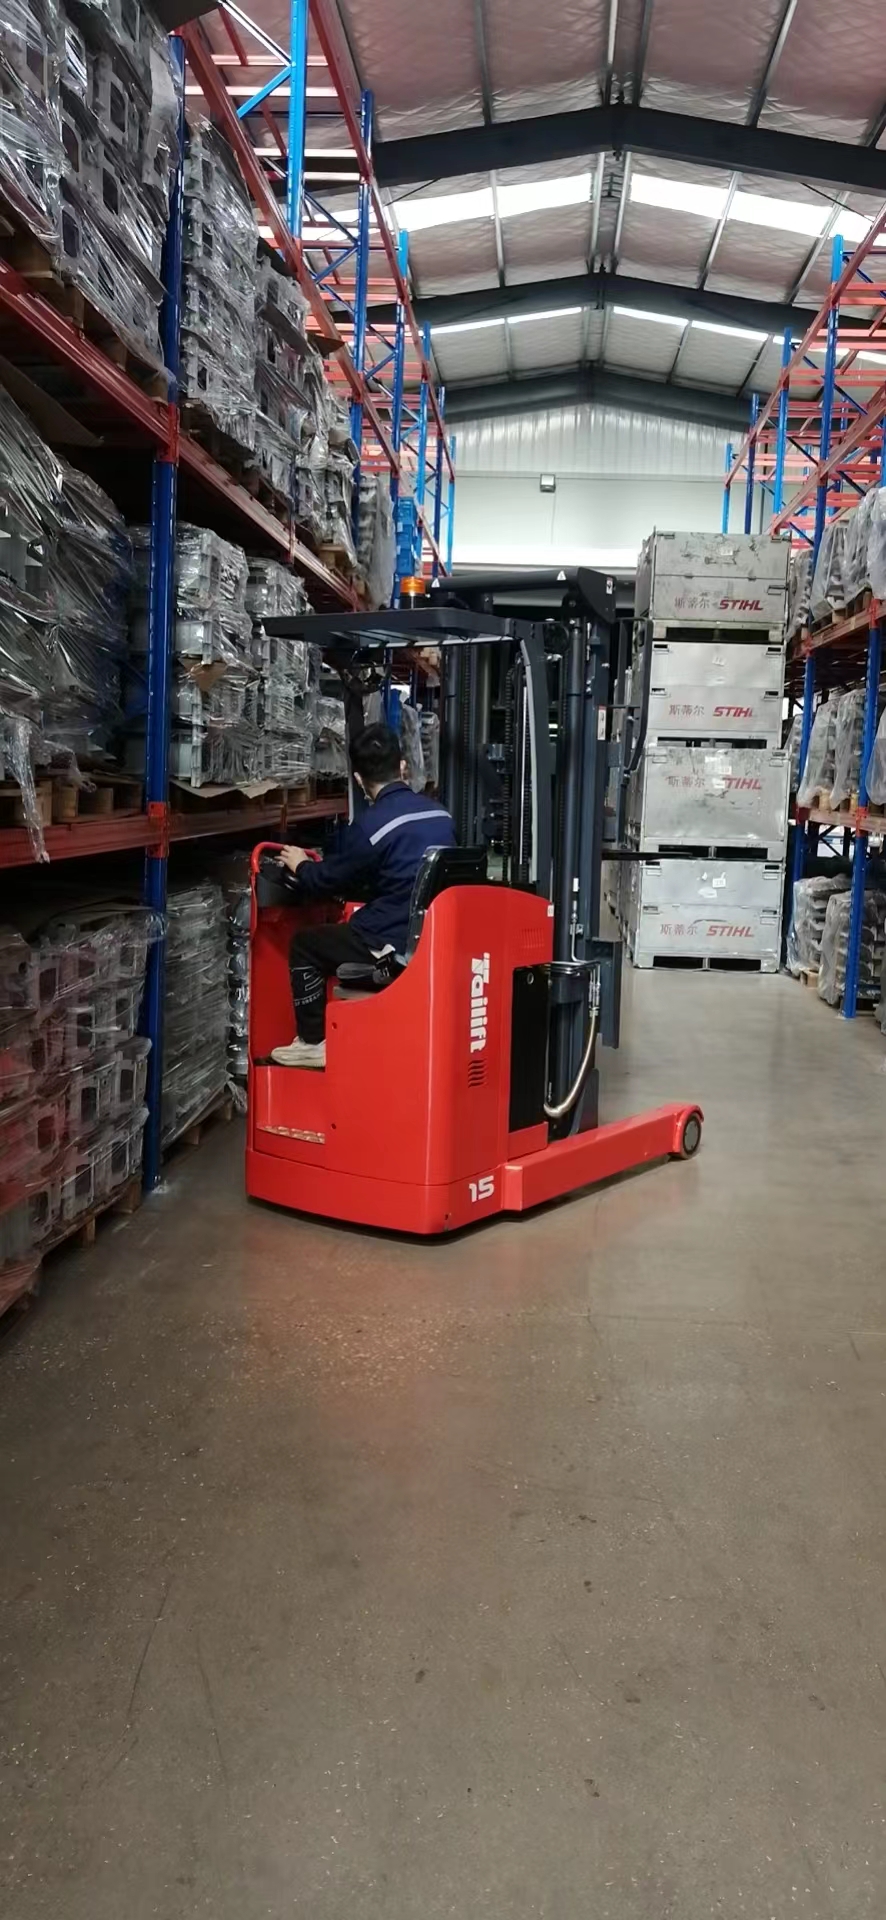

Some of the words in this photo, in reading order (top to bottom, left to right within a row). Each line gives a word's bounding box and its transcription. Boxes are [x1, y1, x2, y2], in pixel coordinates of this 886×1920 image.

[718, 599, 764, 611] STIHL
[669, 704, 705, 716] 斯蒂尔
[719, 776, 762, 790] TIHL
[660, 924, 698, 936] 斯蒂尔
[706, 925, 754, 938] STIHL
[470, 952, 490, 1053] Tailift
[468, 1175, 495, 1203] 15
